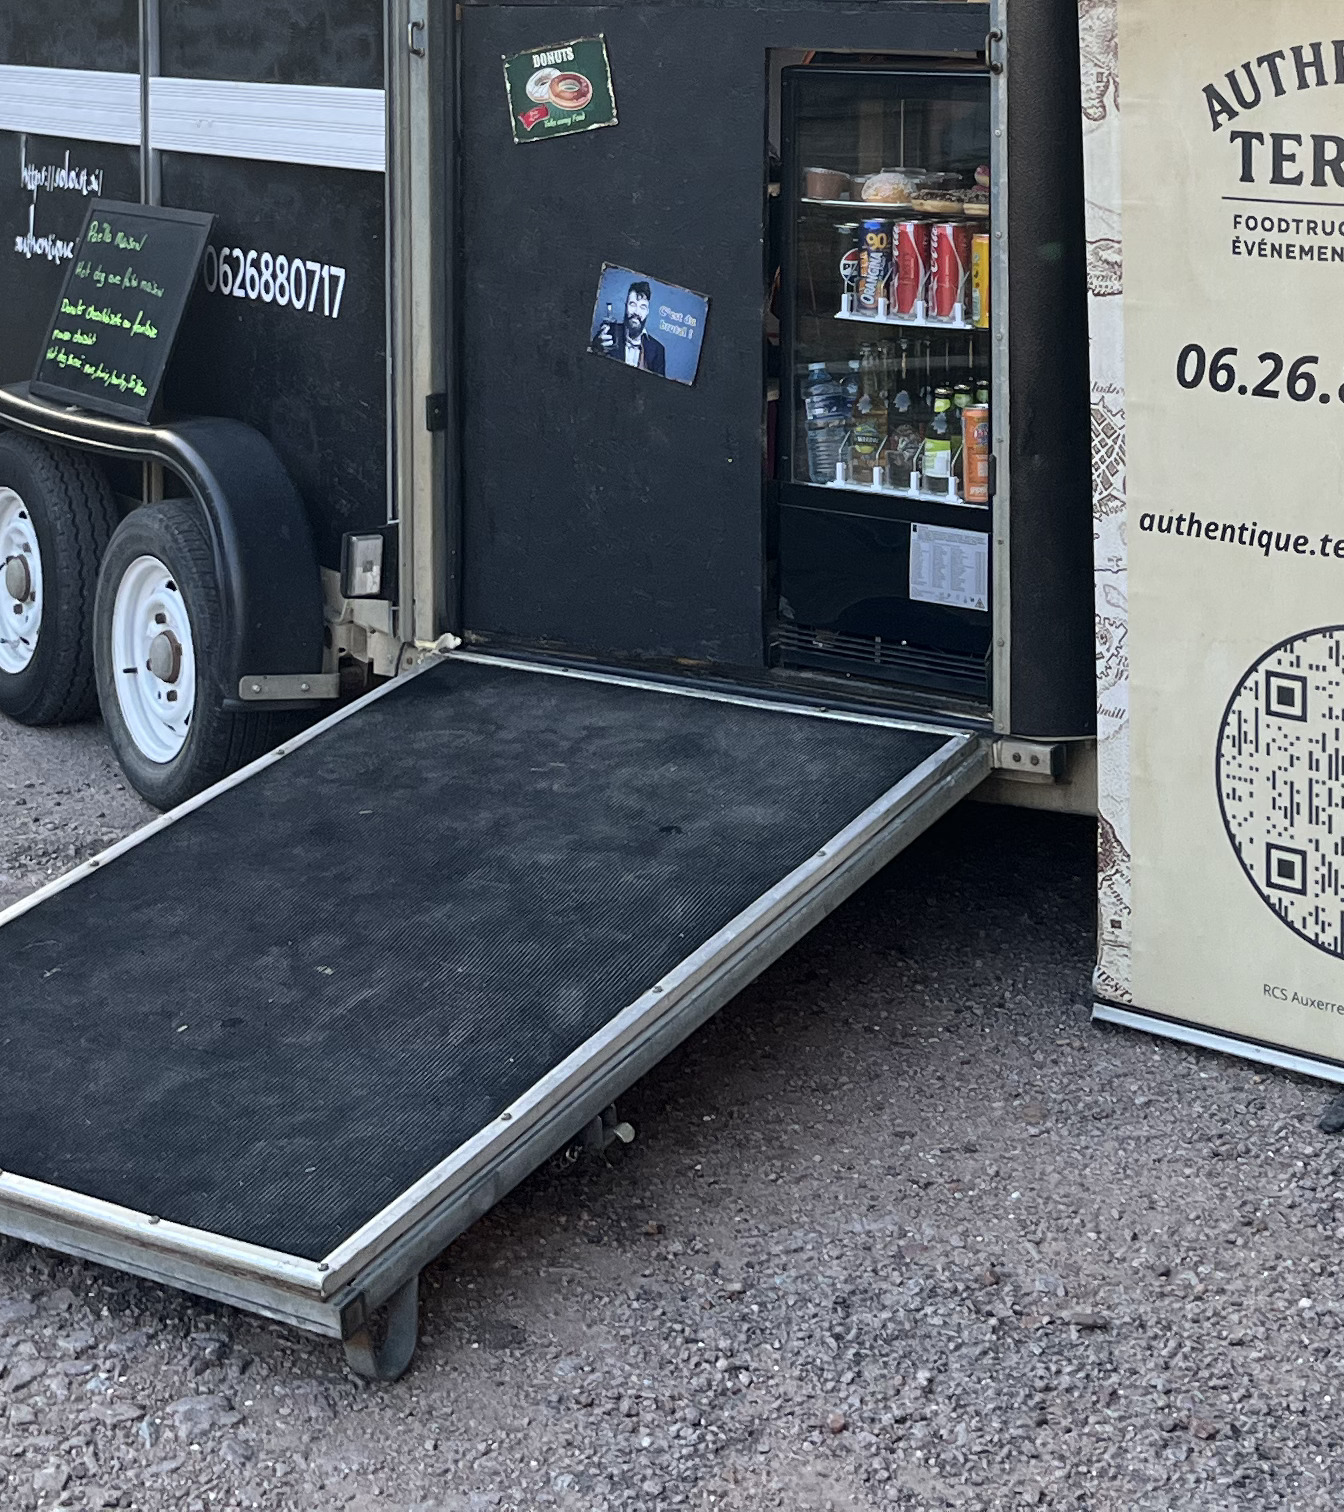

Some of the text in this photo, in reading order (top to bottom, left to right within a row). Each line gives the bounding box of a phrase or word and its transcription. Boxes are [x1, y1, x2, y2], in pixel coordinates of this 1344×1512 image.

[532, 47, 575, 68] DONUTS
[865, 232, 888, 251] 90
[203, 245, 347, 319] 0626880717
[683, 314, 697, 327] du
[1263, 983, 1288, 1001] RCS
[1291, 991, 1344, 1016] Auxerre
